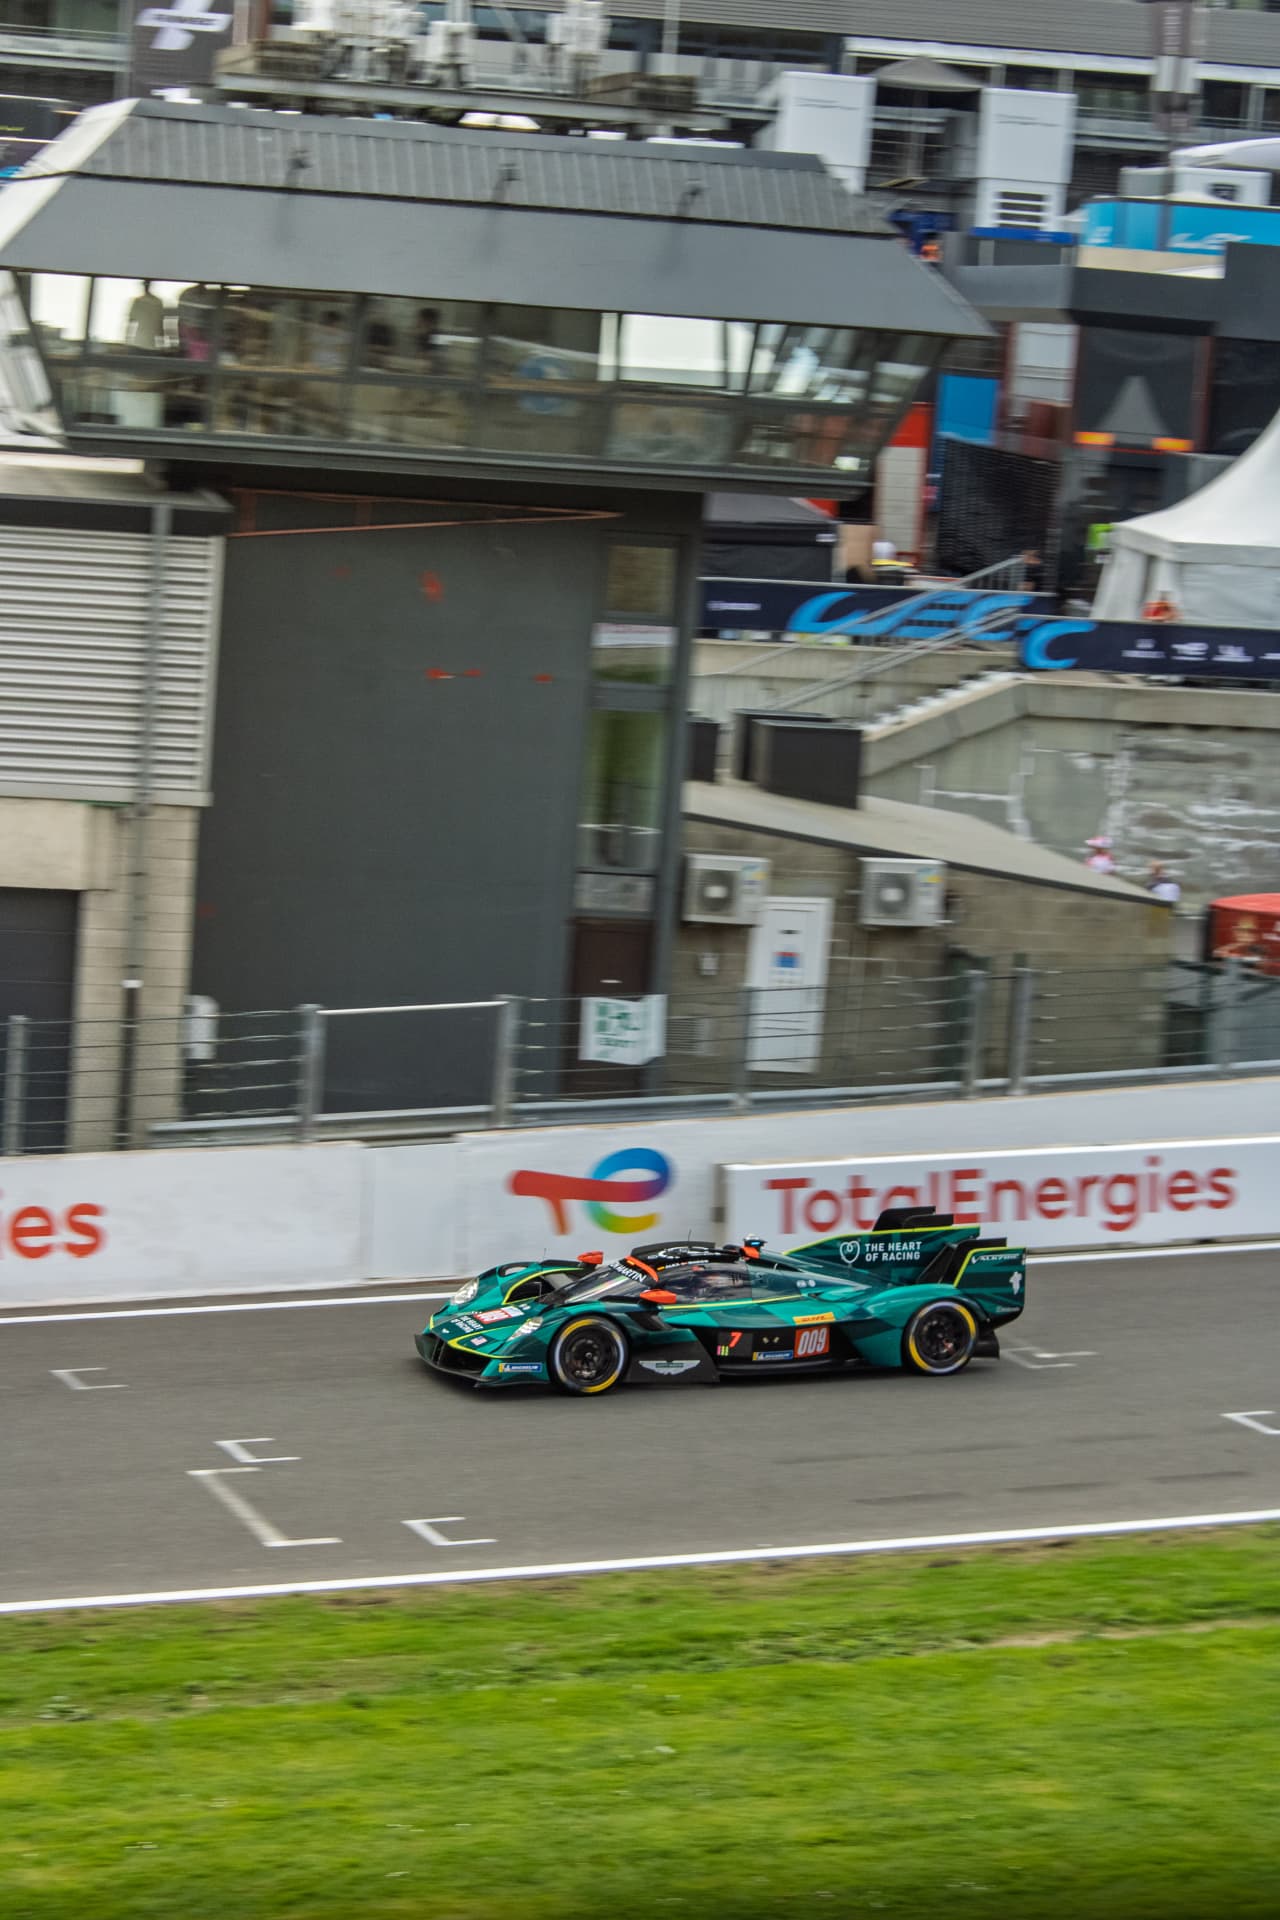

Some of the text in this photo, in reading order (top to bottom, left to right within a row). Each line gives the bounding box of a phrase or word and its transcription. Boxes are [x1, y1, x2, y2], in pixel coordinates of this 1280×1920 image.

[765, 1156, 1237, 1235] TotalEnergies
[0, 1203, 106, 1258] es
[865, 1242, 922, 1252] THE HEART
[865, 1252, 921, 1262] OF RACING
[728, 1331, 742, 1348] 7
[797, 1327, 828, 1356] 009
